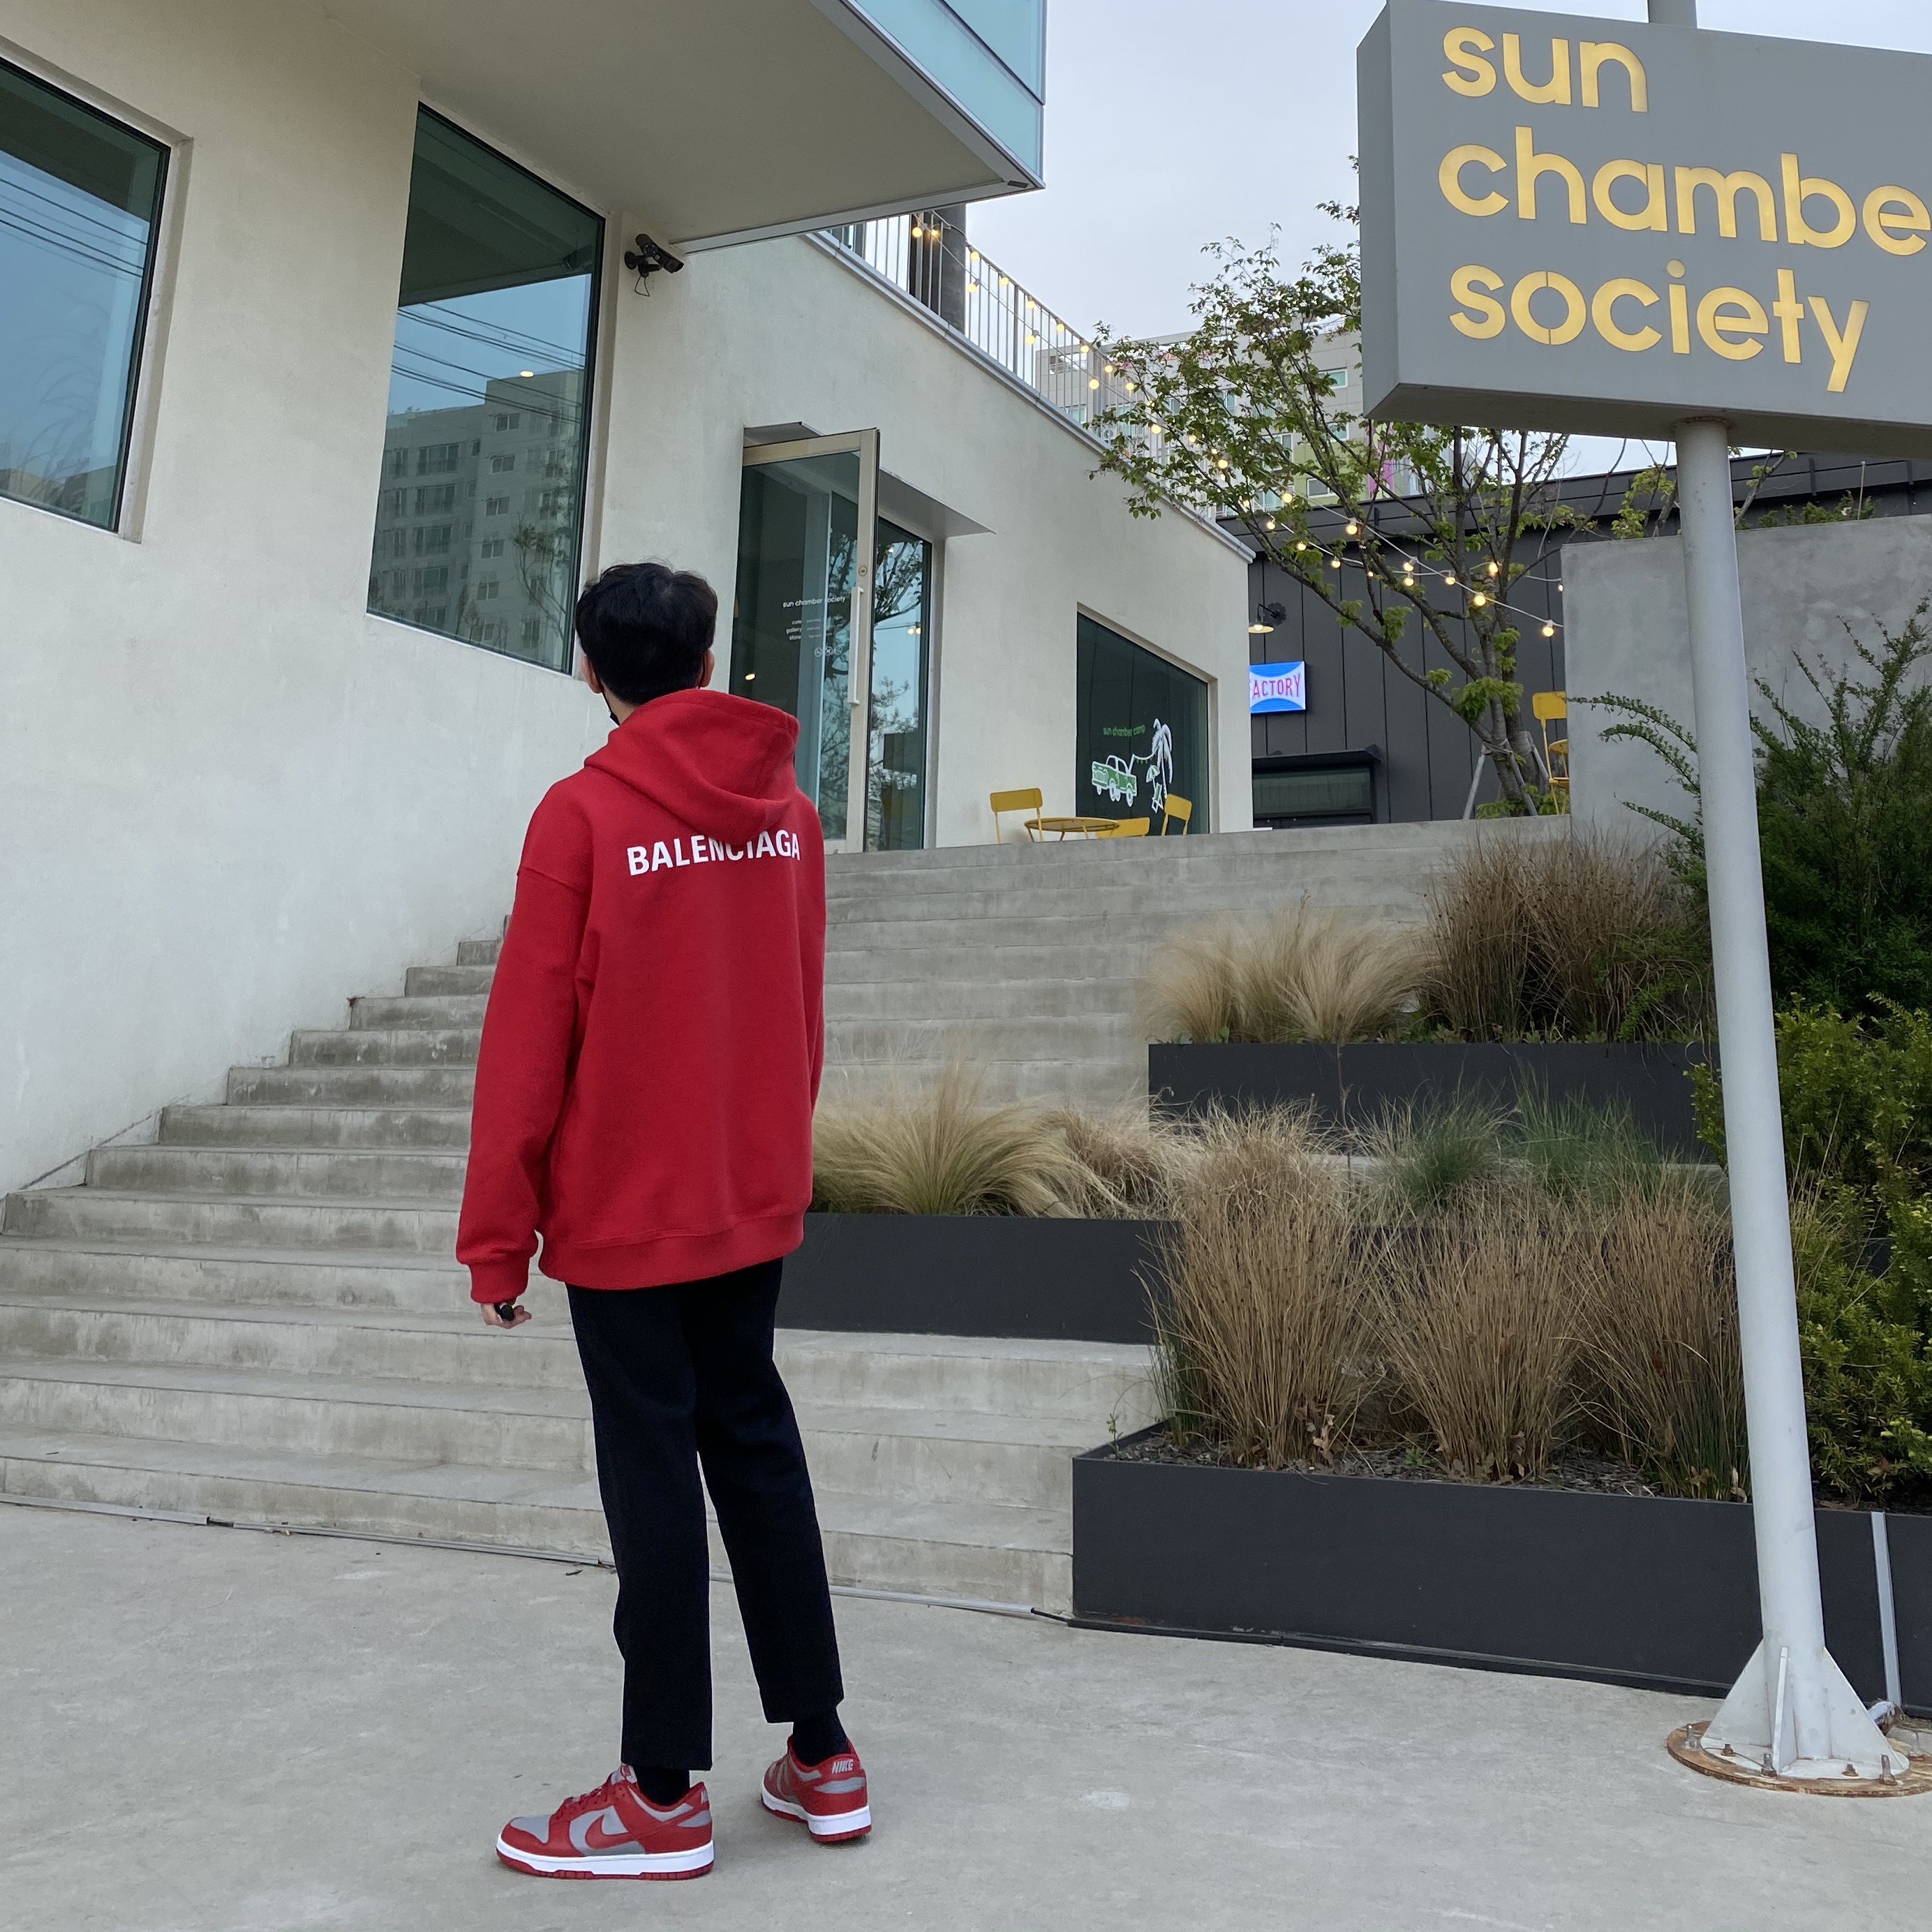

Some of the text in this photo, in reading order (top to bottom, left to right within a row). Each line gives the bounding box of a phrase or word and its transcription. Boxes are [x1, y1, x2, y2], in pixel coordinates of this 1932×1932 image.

[1442, 26, 1648, 112] sun
[1438, 126, 1931, 256] chambe
[1449, 259, 1871, 392] society
[795, 598, 823, 607] chamber
[1249, 673, 1302, 699] ACTORY
[831, 1758, 854, 1774] NIKE
